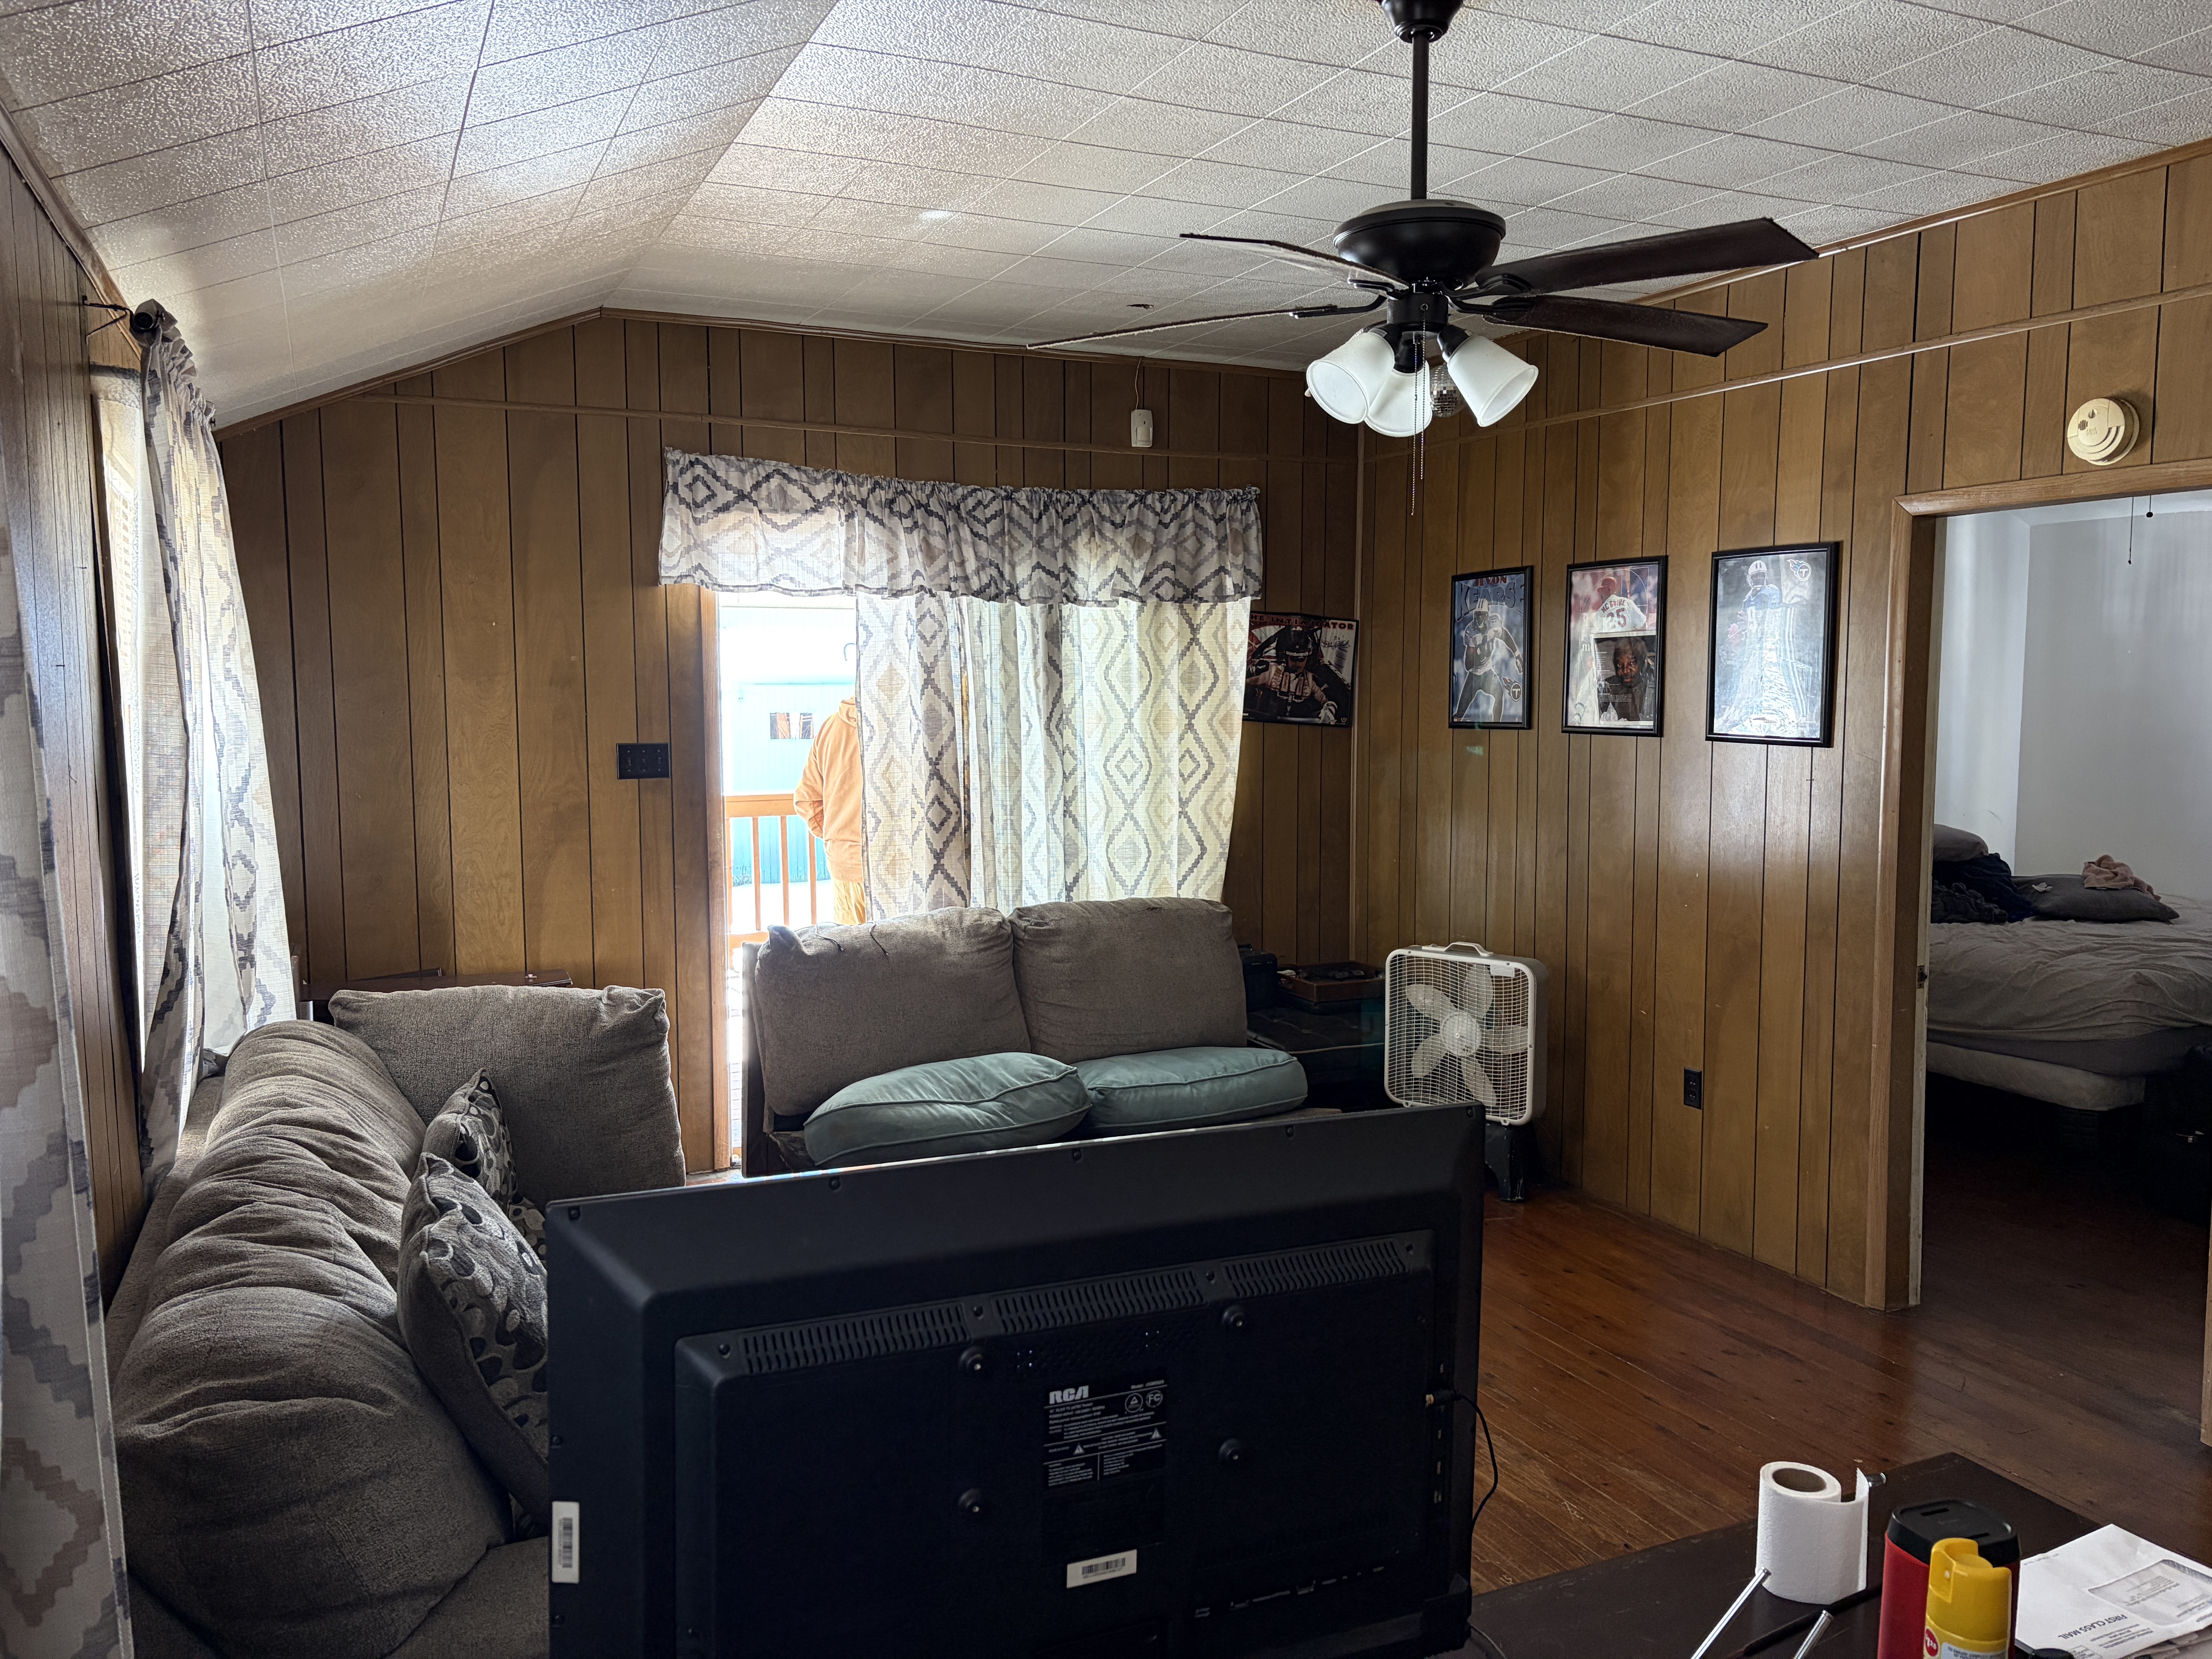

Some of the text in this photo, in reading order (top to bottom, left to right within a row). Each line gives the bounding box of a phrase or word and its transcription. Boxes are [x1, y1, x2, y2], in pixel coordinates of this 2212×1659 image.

[1457, 574, 1524, 621] KEARSE
[1271, 617, 1354, 630] INTIMIDATOR
[1606, 608, 1626, 630] 25
[1049, 1385, 1089, 1405] RCA
[2058, 1614, 2128, 1640] FIRST CLASS MAIL
